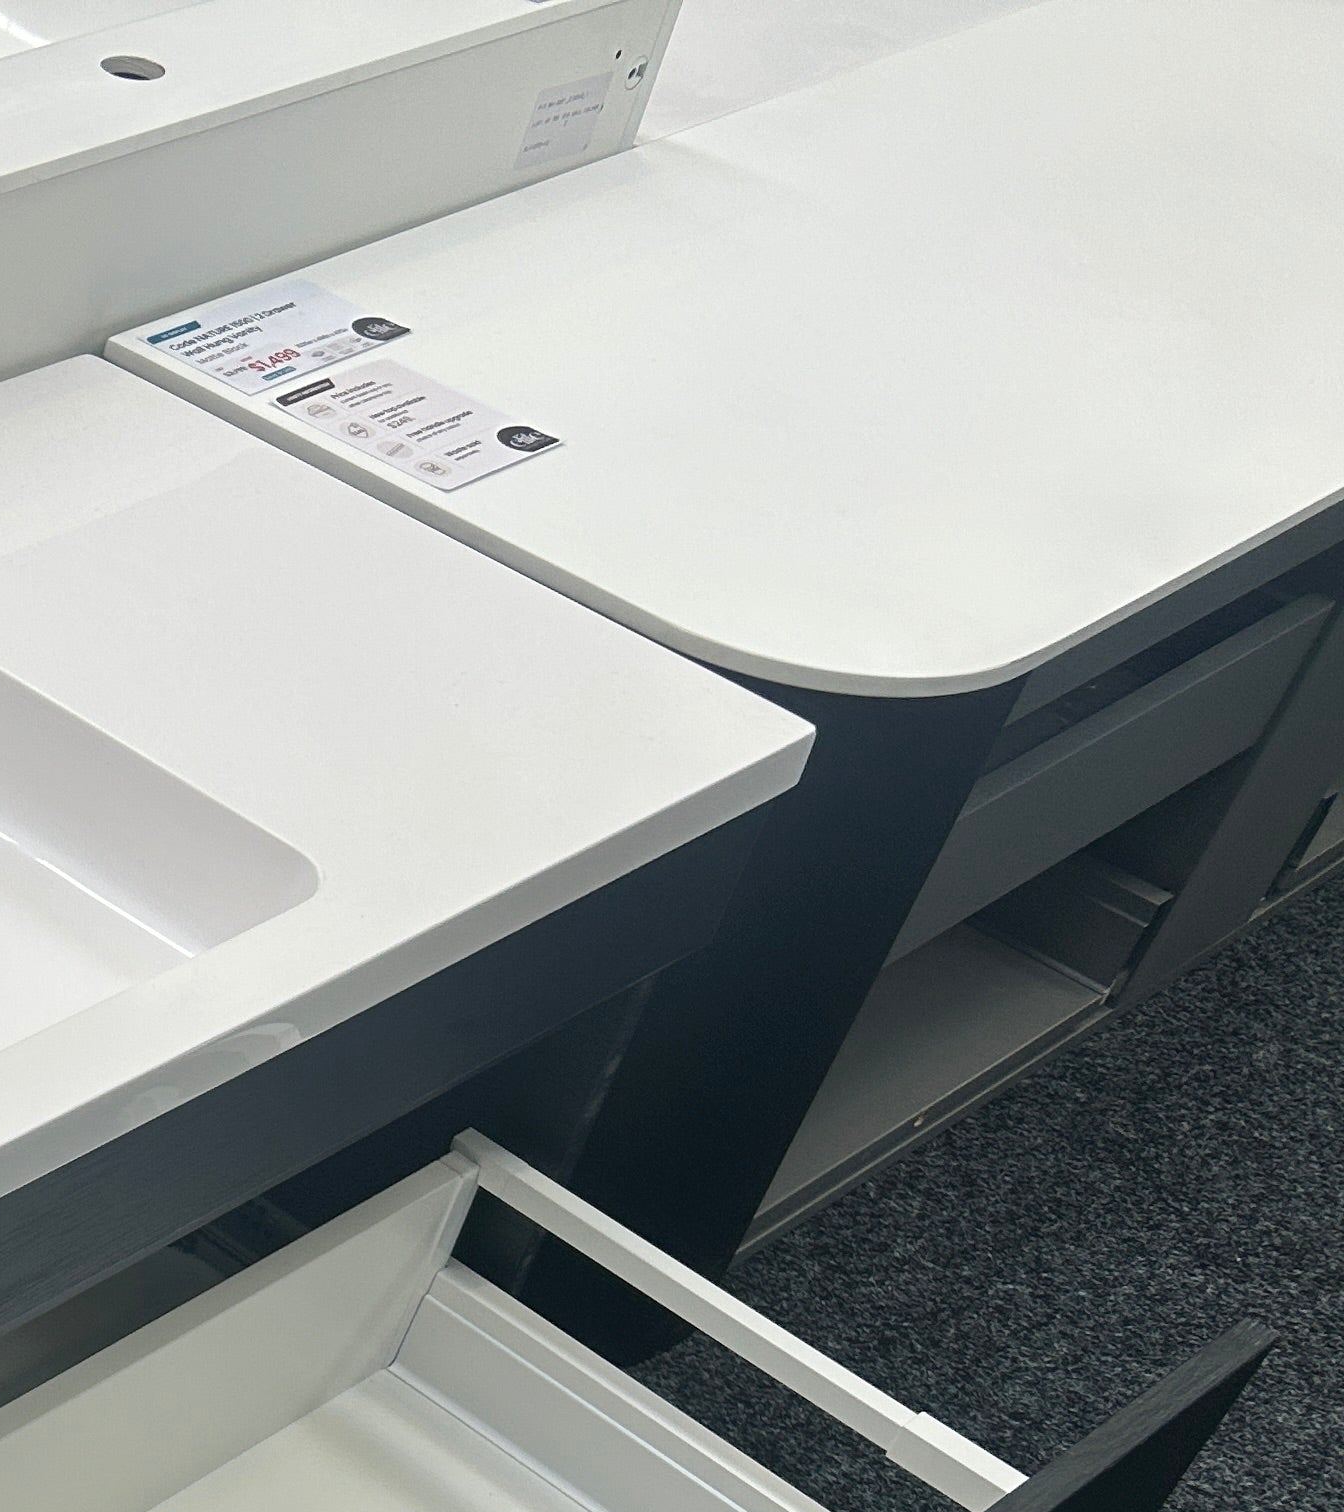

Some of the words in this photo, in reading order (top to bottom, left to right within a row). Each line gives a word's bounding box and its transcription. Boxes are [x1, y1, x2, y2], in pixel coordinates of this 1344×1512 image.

[166, 338, 198, 351] Code
[192, 323, 234, 342] NATURE
[259, 300, 298, 317] Drawer
[180, 345, 206, 357] Wall
[201, 336, 235, 350] Hung
[227, 325, 264, 340] Vanity
[245, 347, 303, 373] $1,499
